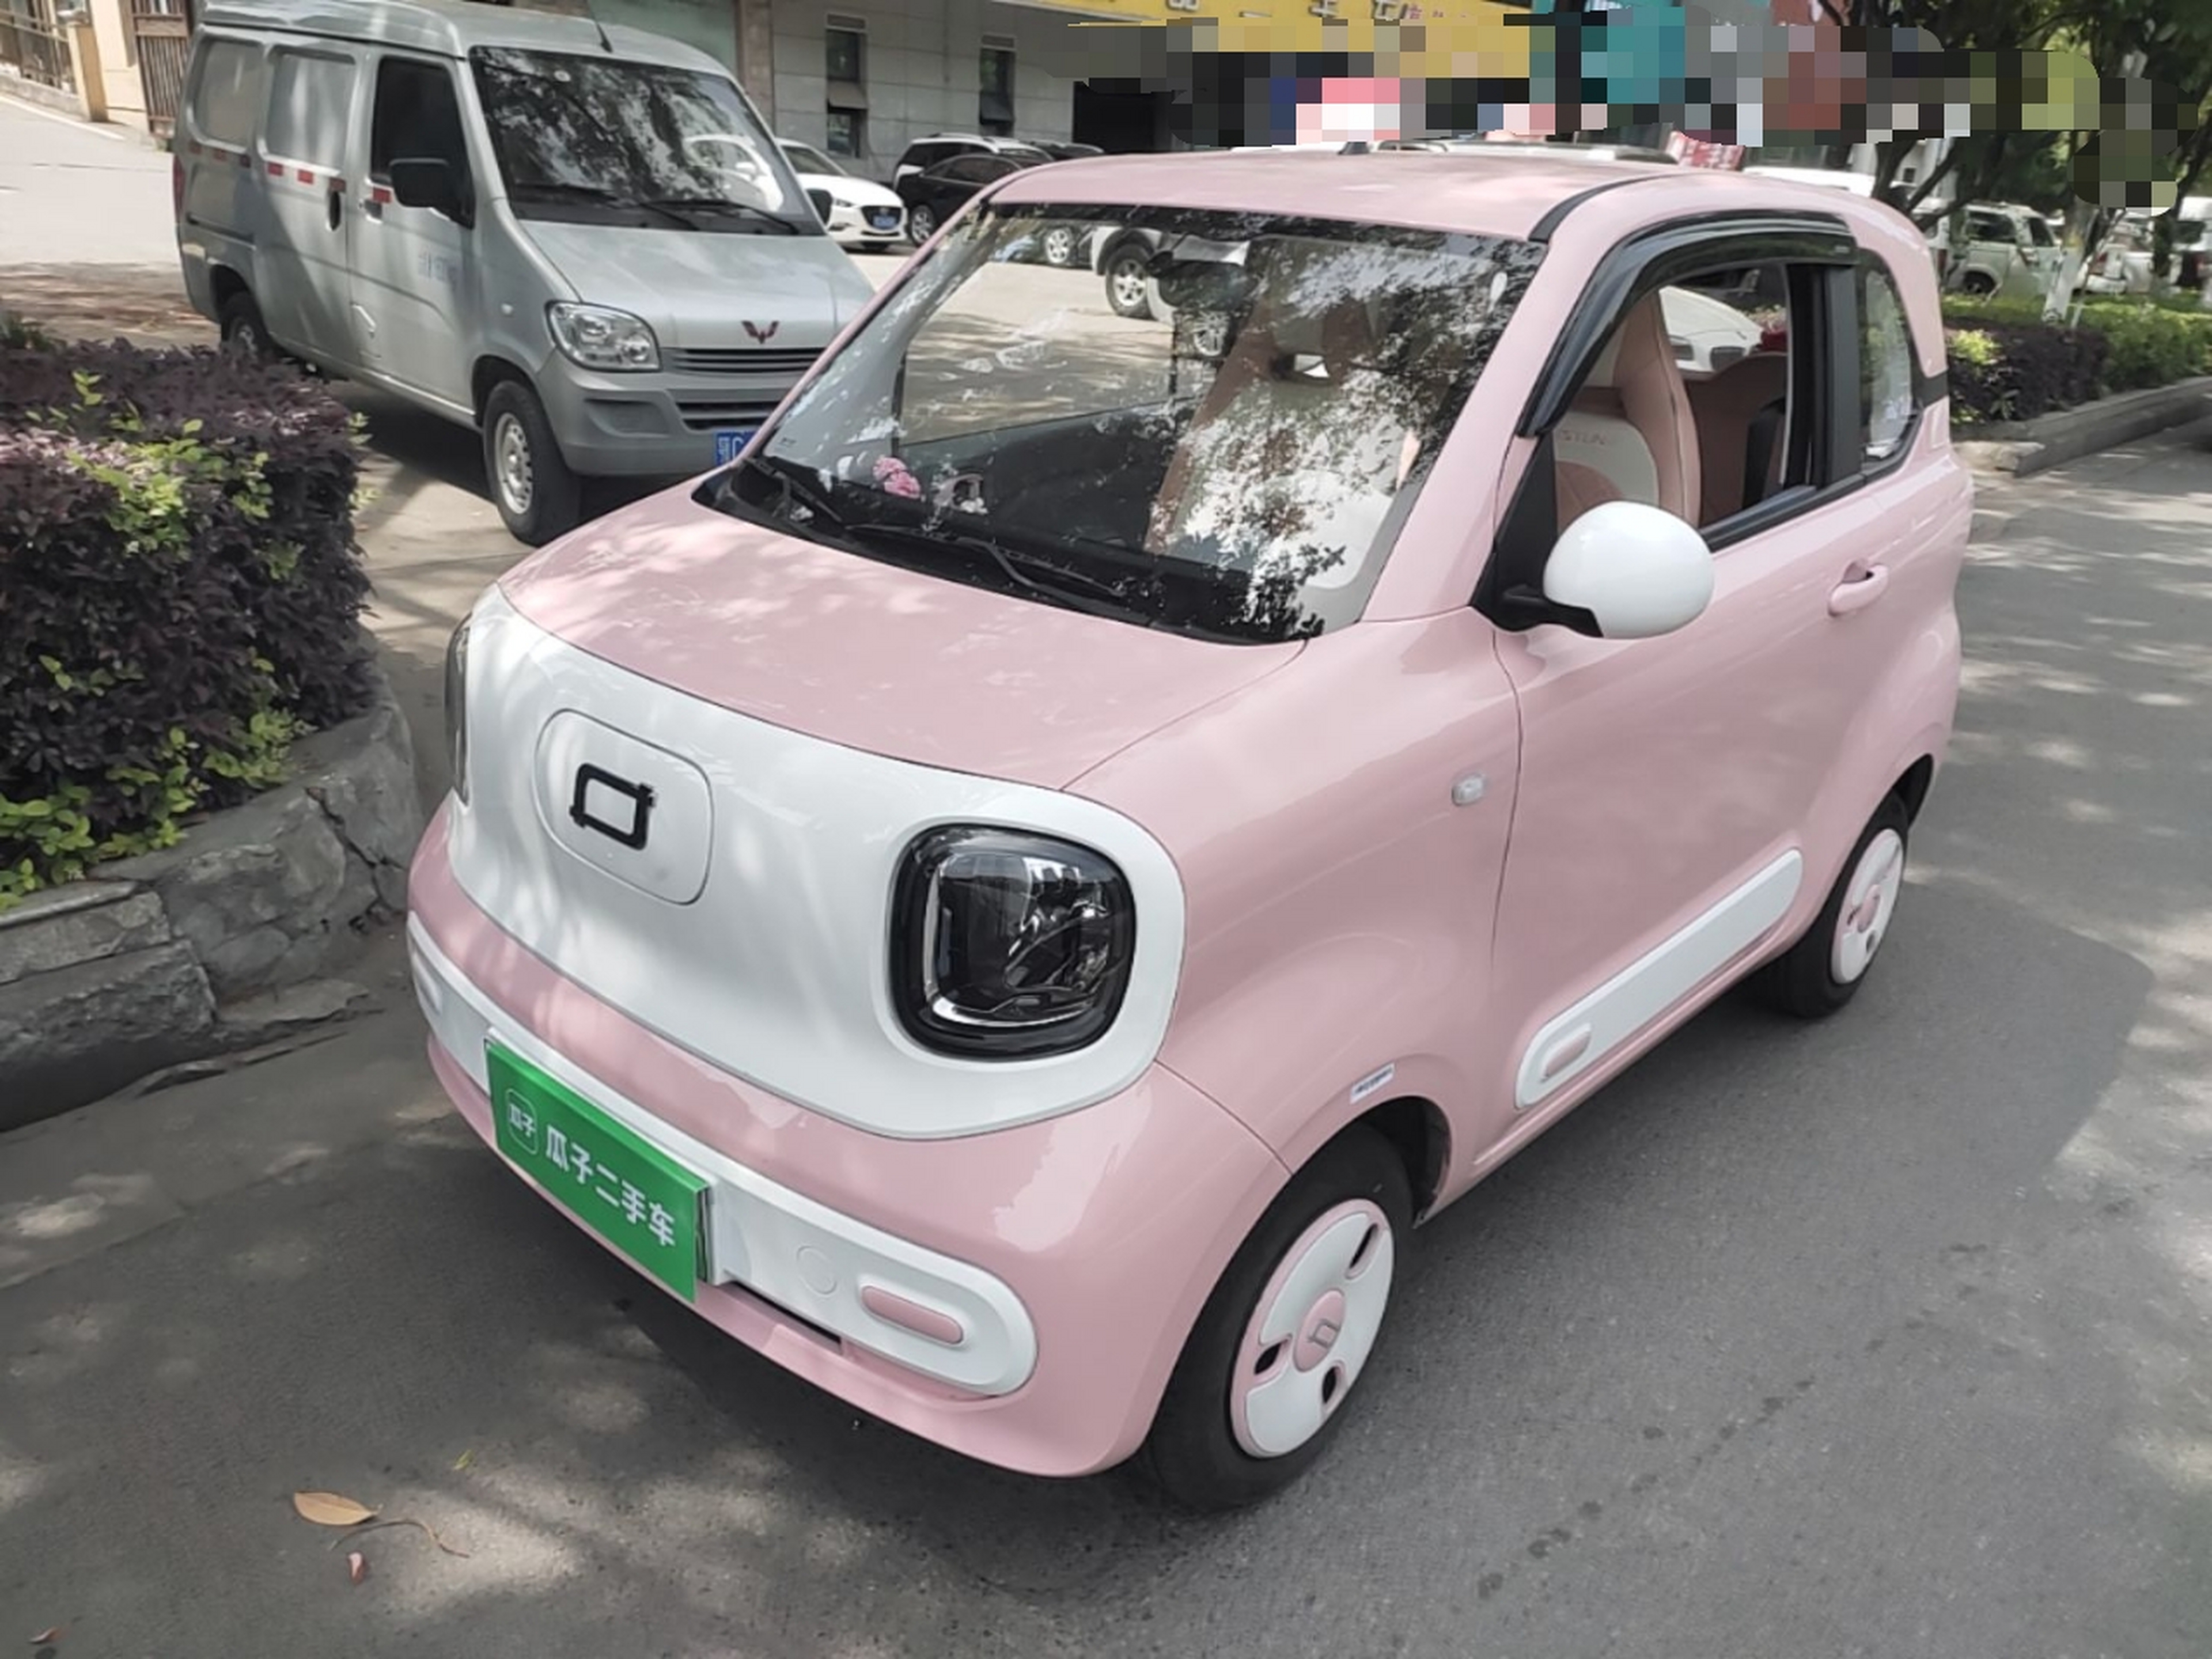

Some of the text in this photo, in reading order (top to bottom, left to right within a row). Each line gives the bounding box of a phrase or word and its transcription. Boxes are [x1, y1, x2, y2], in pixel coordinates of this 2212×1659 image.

[547, 1125, 674, 1246] 瓜子二手车
